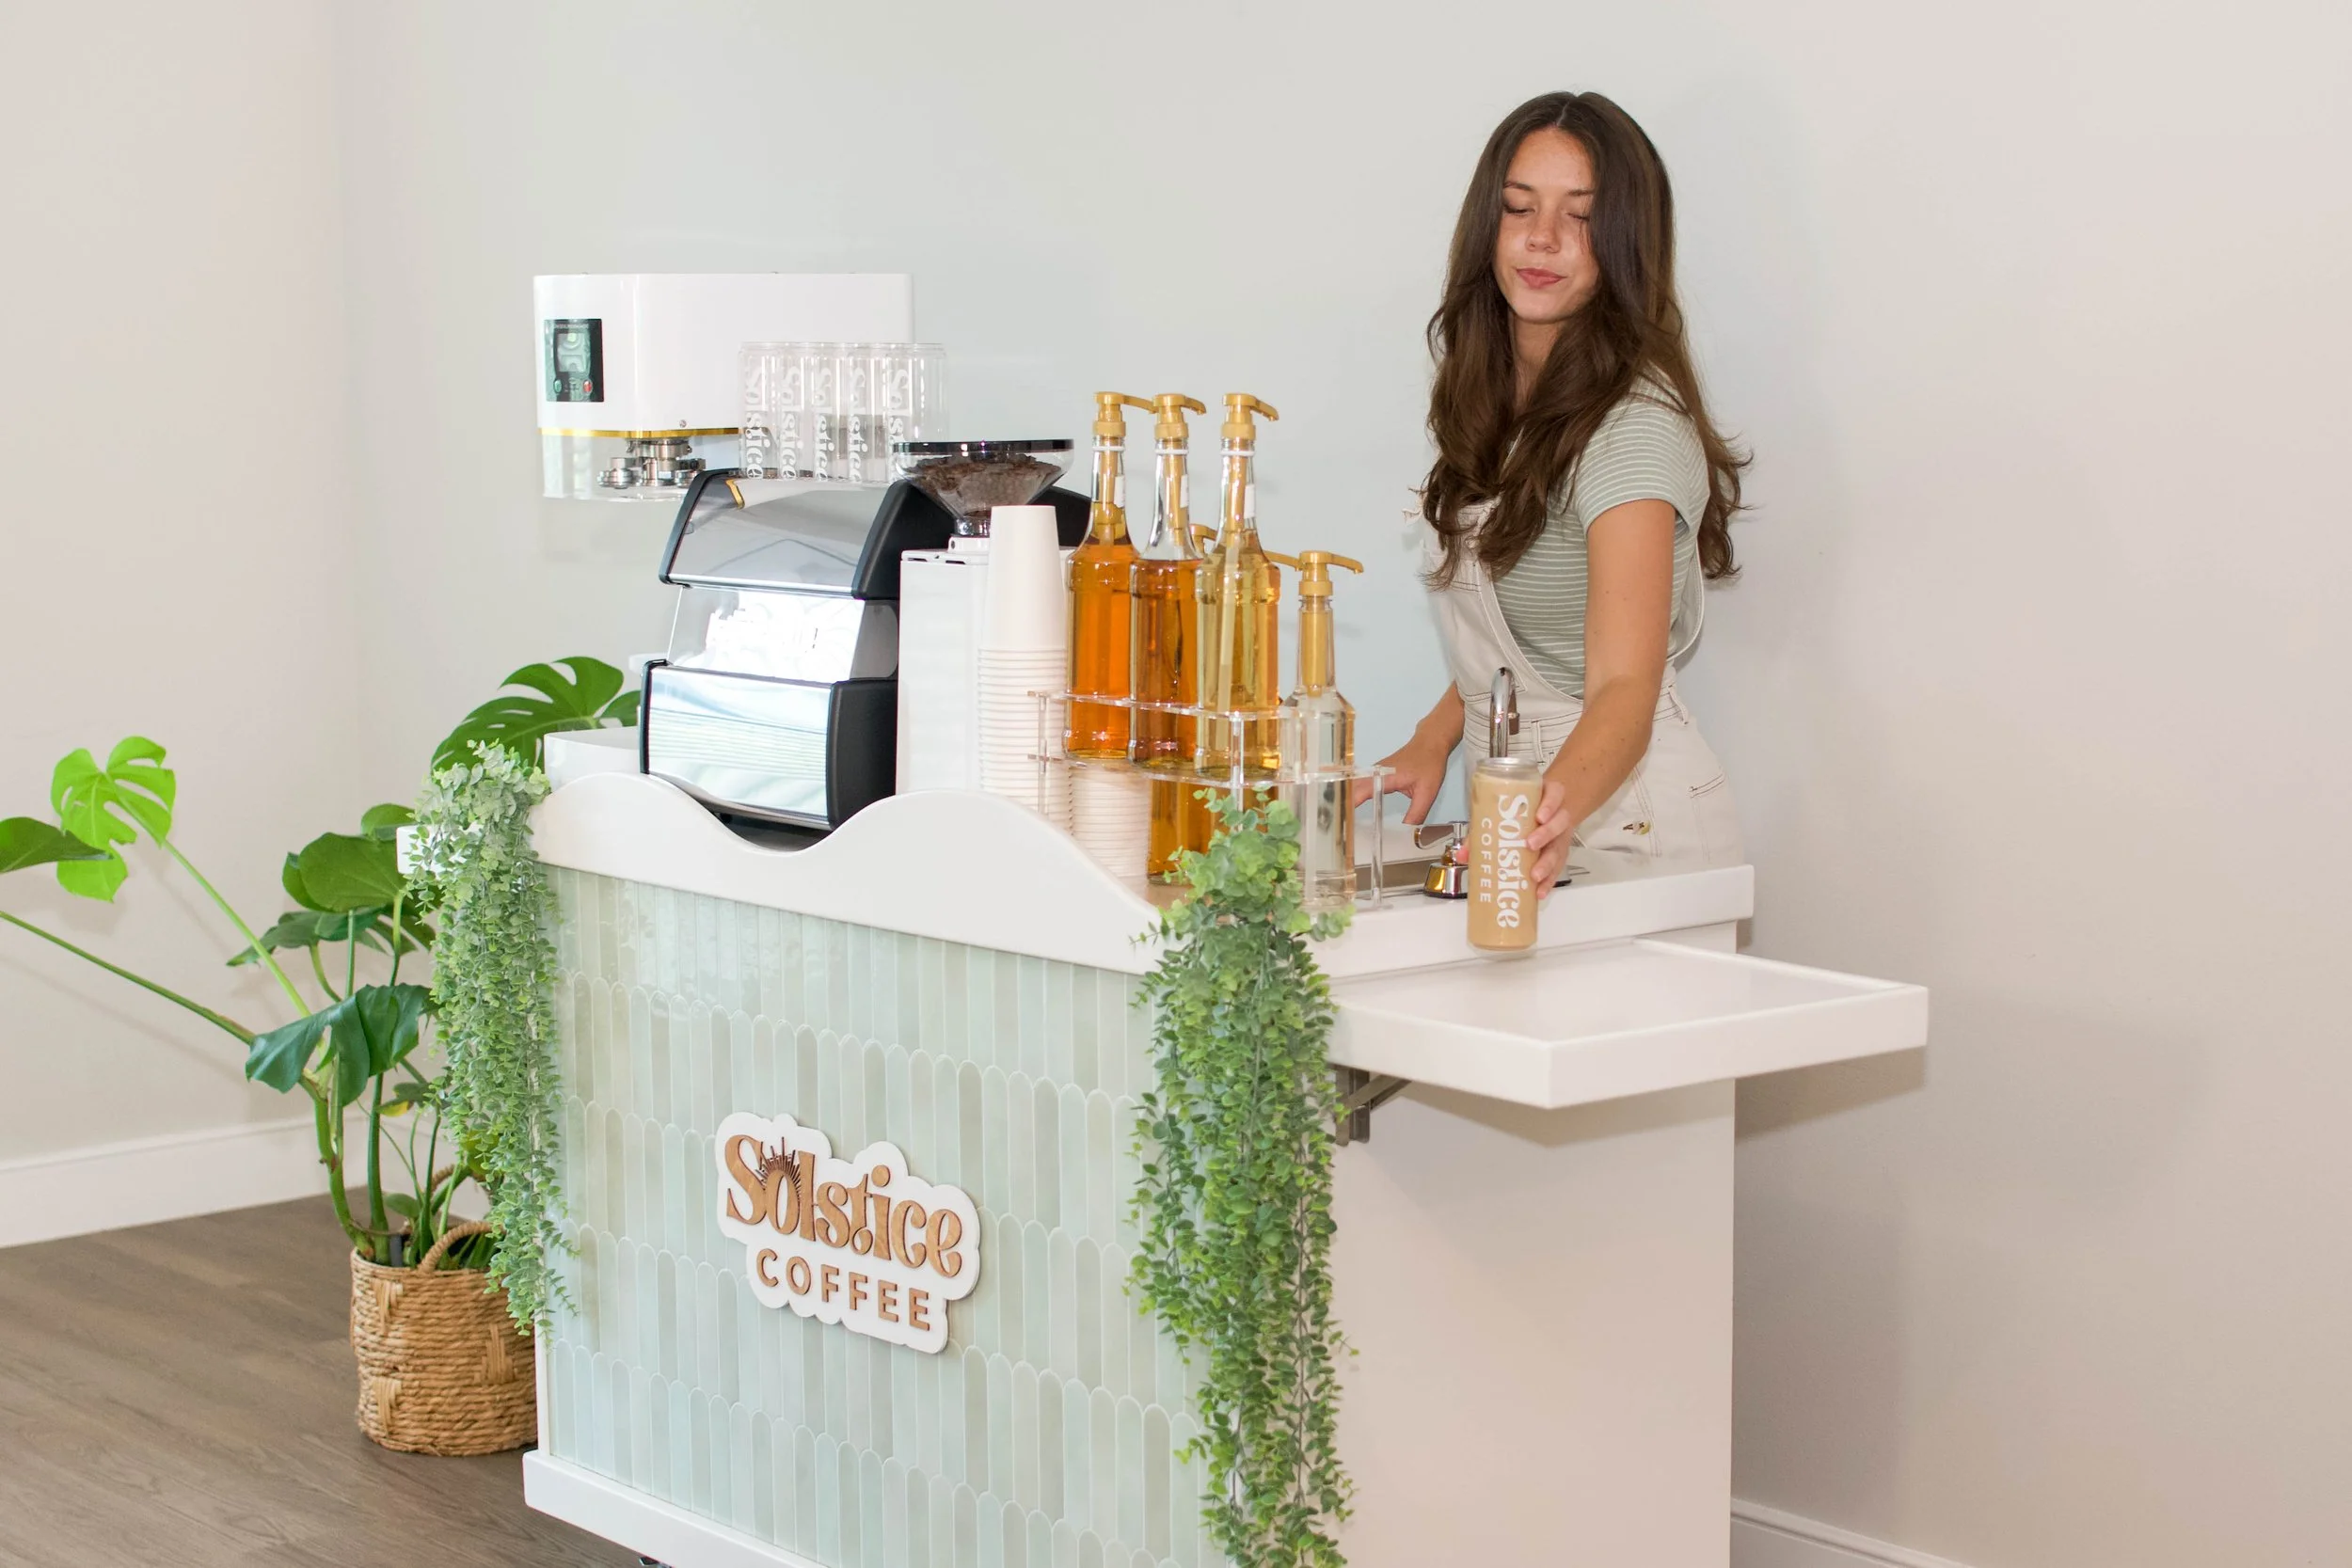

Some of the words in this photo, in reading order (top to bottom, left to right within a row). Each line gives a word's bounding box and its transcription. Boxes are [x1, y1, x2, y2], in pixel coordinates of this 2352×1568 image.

[745, 366, 771, 480] Solstice
[780, 366, 804, 481] Solstice
[813, 367, 834, 482] Solstice
[1479, 817, 1493, 903] COFFEE
[1496, 794, 1529, 928] Solstice
[724, 1134, 963, 1278] Solstice
[755, 1248, 930, 1332] COFFEE
